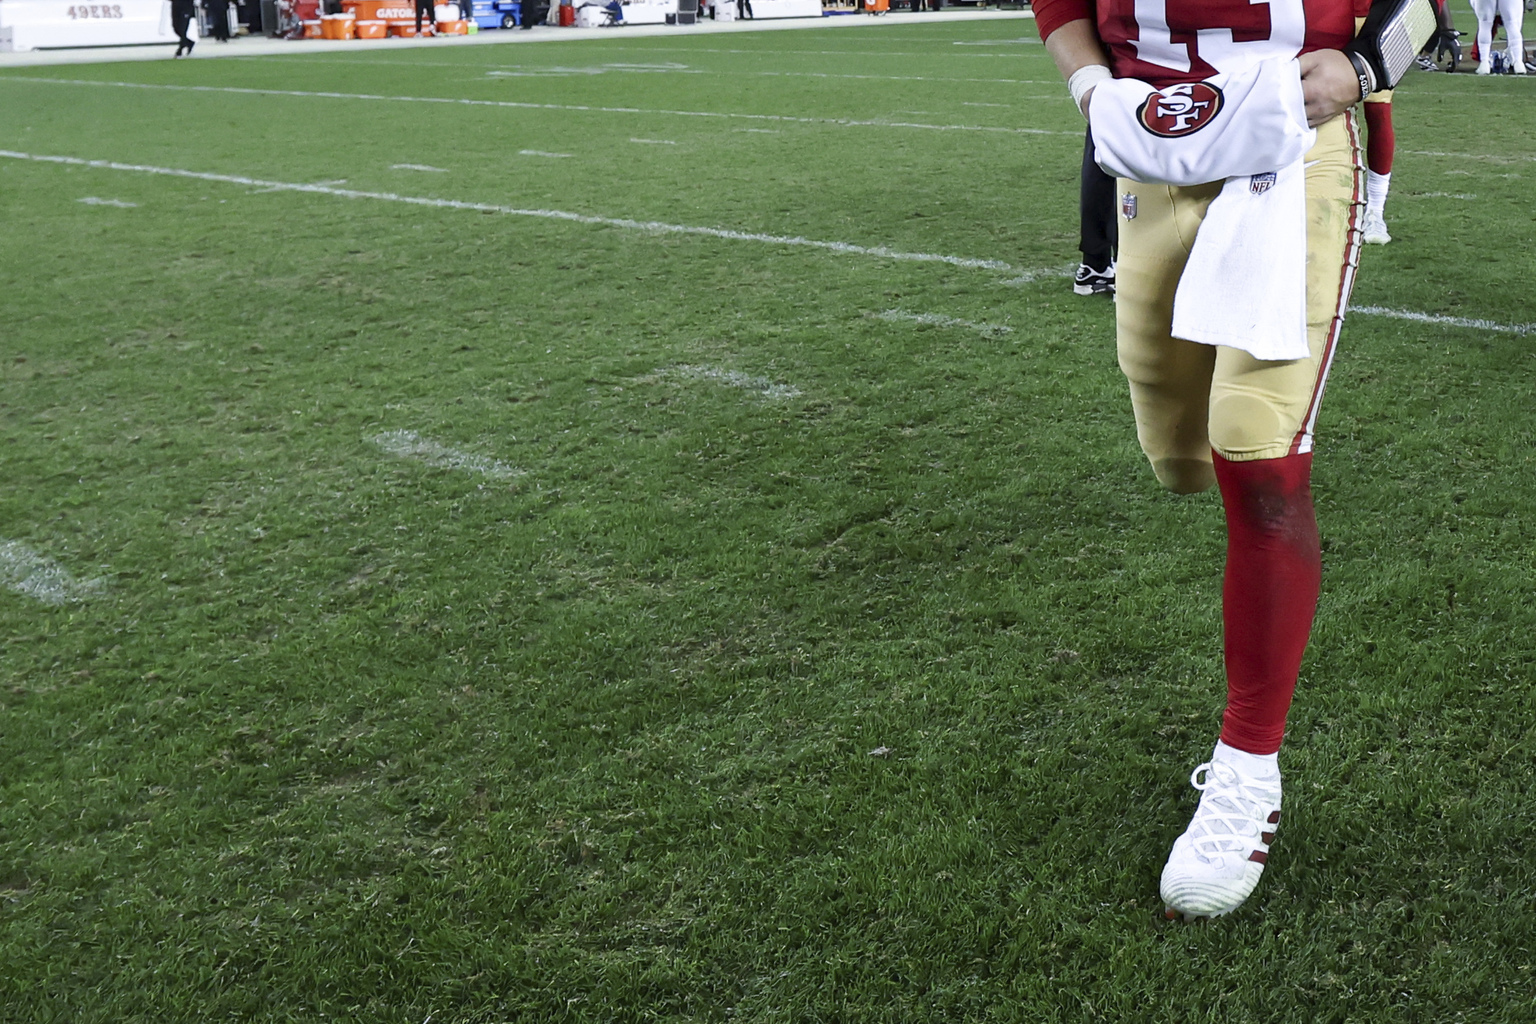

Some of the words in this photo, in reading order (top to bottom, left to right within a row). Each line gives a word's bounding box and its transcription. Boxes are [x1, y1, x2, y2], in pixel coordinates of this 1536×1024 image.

[66, 4, 123, 20] 49ERS
[376, 7, 428, 19] GATOR
[1251, 181, 1272, 194] NFL
